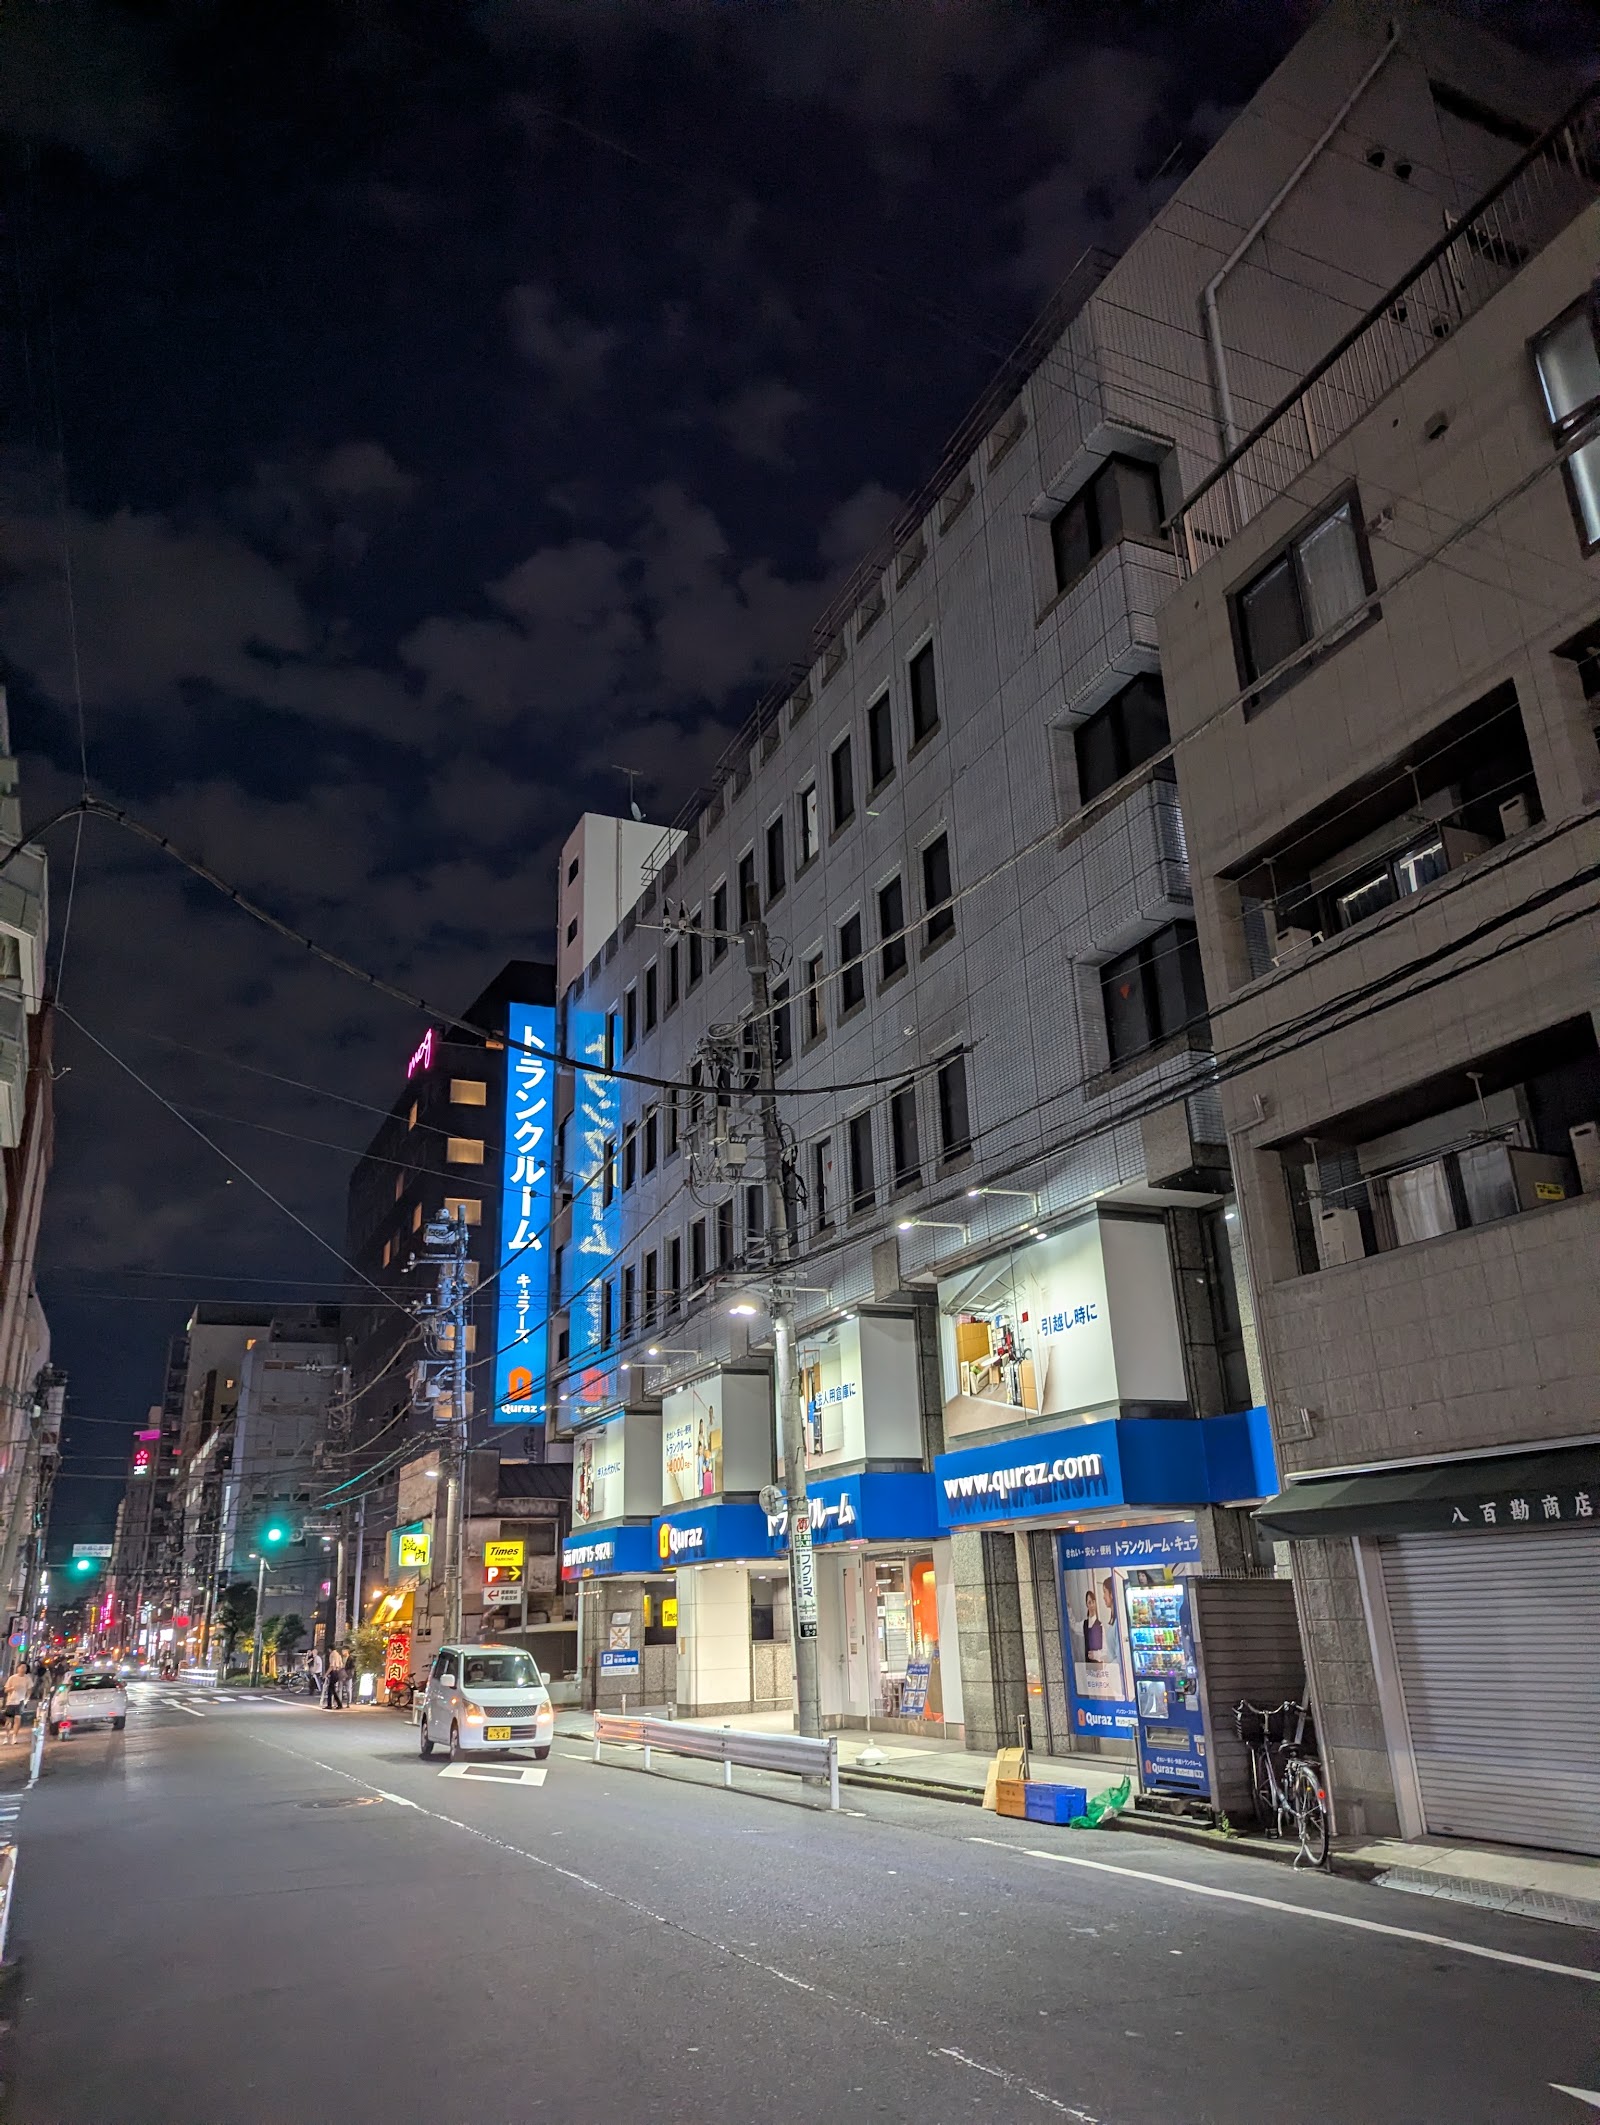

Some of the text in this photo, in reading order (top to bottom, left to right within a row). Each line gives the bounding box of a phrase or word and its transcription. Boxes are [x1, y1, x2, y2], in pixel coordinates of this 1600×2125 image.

[508, 1025, 547, 1252] トランクルーム
[514, 1273, 532, 1344] キュラーズ
[1041, 1303, 1098, 1337] 引越し時に
[816, 1382, 856, 1407] 法人用倉庫に
[501, 1403, 538, 1415] Quraz
[943, 1453, 1103, 1500] www.quraz.com
[1451, 1491, 1594, 1524] 八百勘商店
[403, 1537, 427, 1564] 焼肉
[490, 1546, 519, 1556] Times
[669, 1527, 703, 1555] Quraz
[1065, 1545, 1112, 1559] きれい・安心・便利
[487, 1567, 499, 1583] P
[801, 1554, 813, 1598] フクシマ
[388, 1642, 404, 1682] 焼肉
[604, 1655, 612, 1664] P
[1085, 1711, 1113, 1727] Quraz
[1151, 1762, 1176, 1775] Quraz
